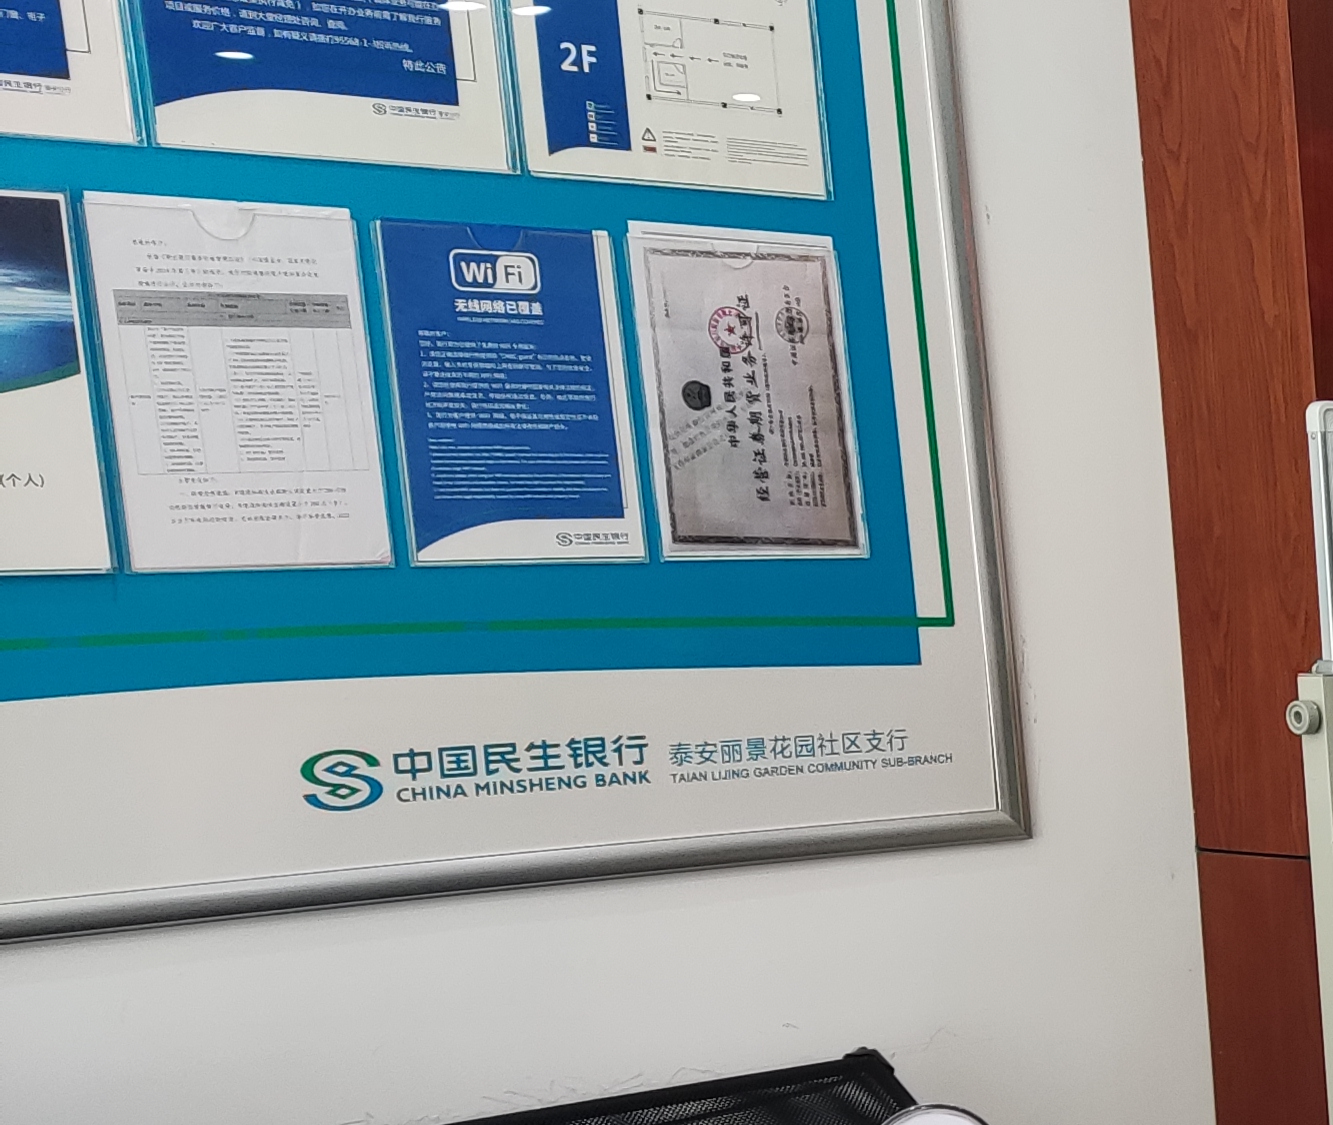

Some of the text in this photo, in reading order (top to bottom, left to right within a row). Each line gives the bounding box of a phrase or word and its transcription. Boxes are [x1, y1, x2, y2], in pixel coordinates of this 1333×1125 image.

[559, 42, 598, 73] 2F
[460, 261, 524, 286] WiFi
[454, 298, 544, 316] 无线网络已覆盖
[393, 729, 909, 781] 中国民生银行 泰安丽景花园社区支行
[396, 752, 954, 803] CHINA MINSHENG BANK TAIAN LIJING GARDEN COMMUNITY SUB-BRANCH
